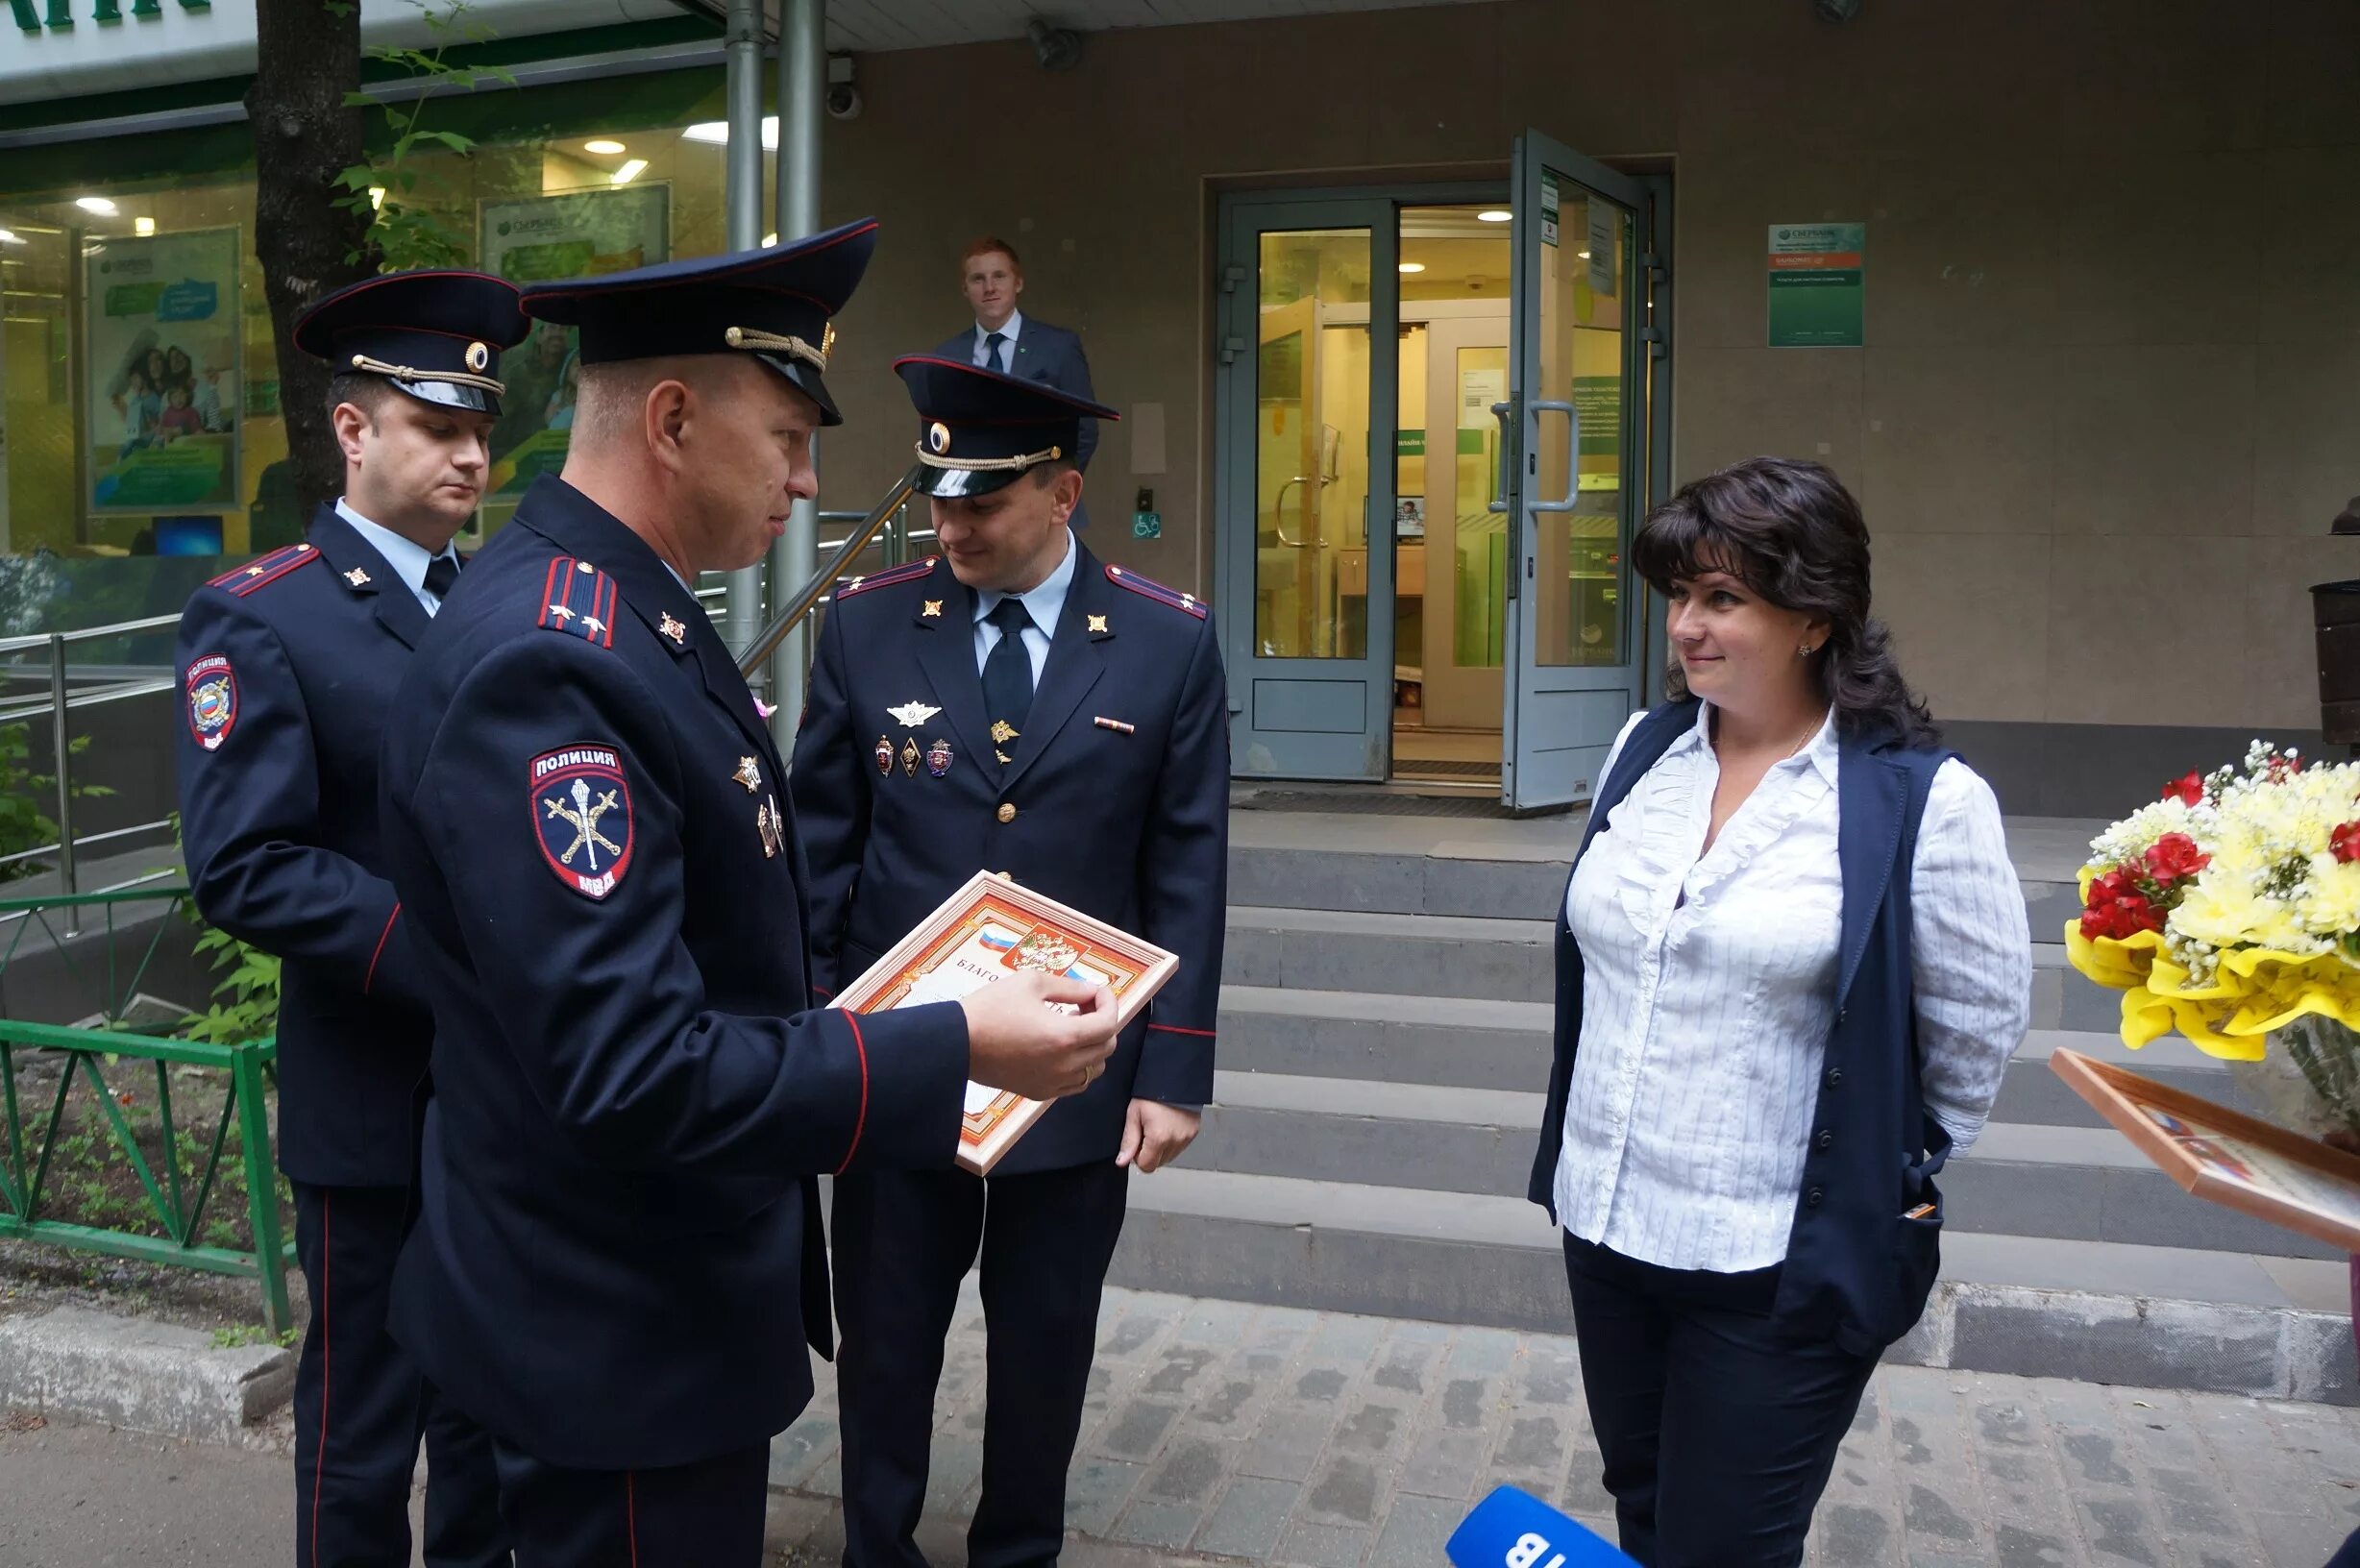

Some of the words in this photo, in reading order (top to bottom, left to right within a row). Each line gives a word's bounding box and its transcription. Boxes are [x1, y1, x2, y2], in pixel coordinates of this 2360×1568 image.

[187, 656, 228, 681] ПОЛИЦИЯ
[204, 731, 224, 749] МВД
[535, 749, 617, 777] ПОЛИЦИЯ
[578, 870, 617, 897] МВД
